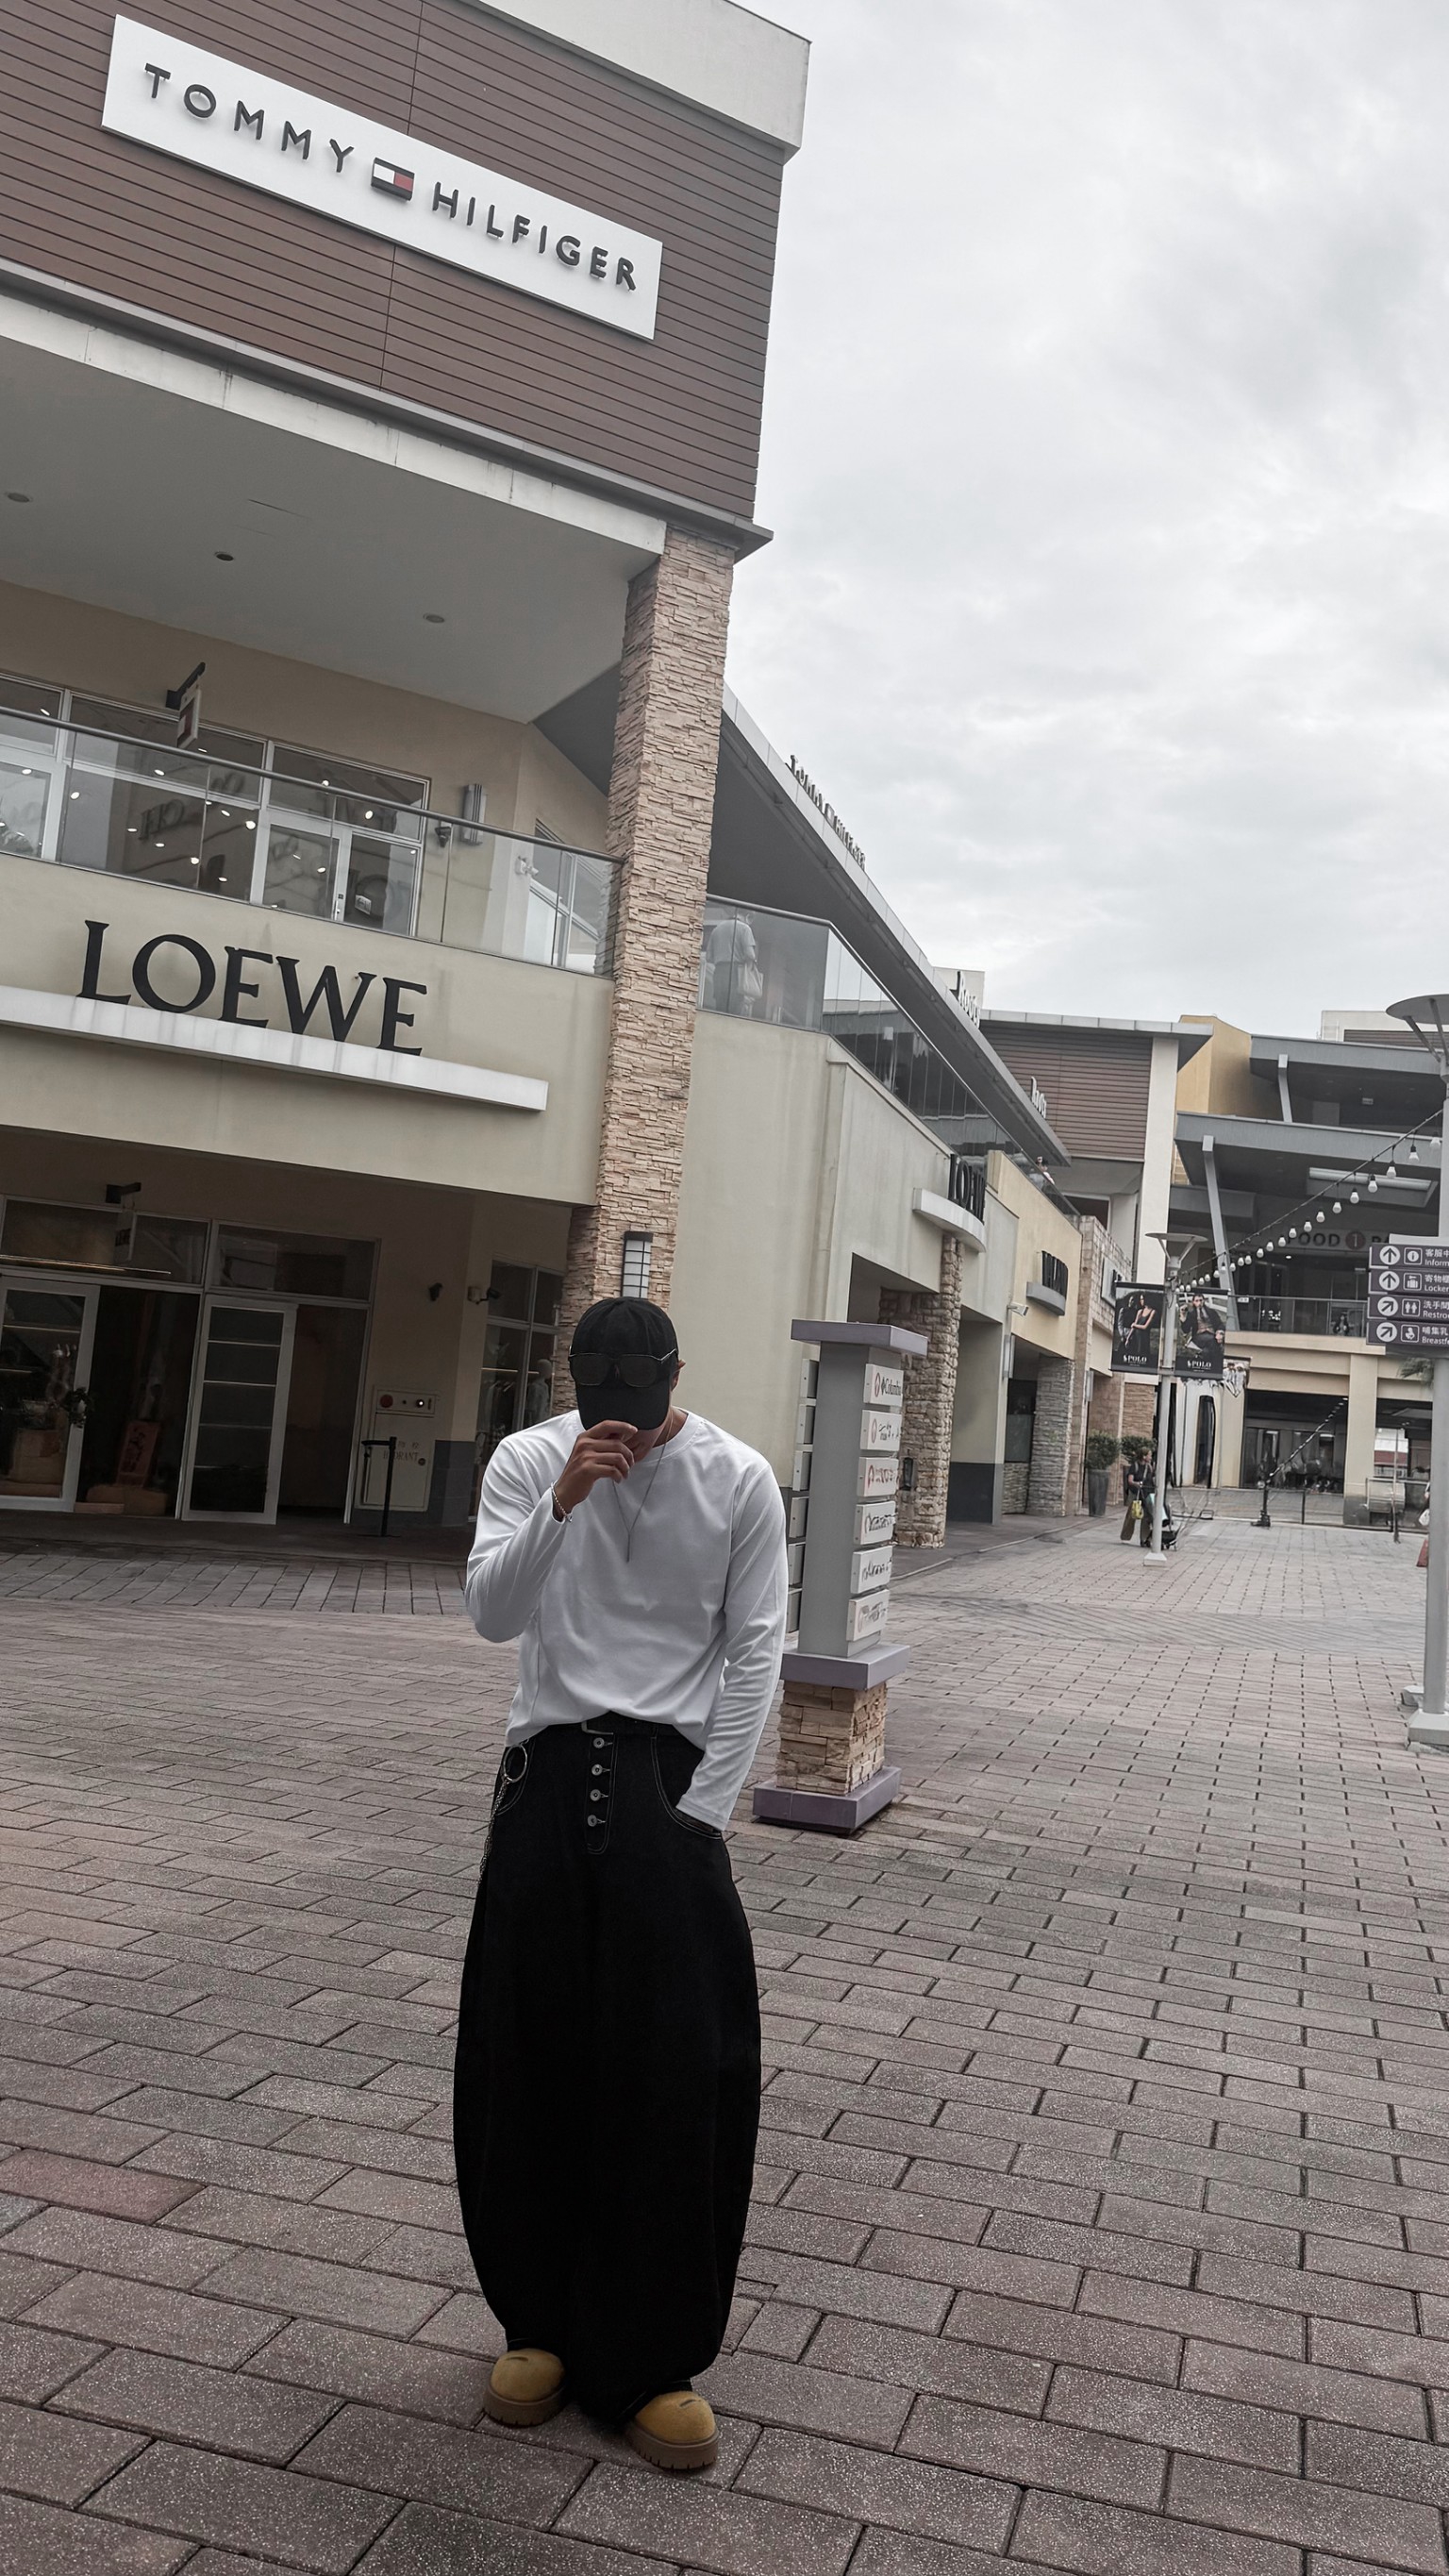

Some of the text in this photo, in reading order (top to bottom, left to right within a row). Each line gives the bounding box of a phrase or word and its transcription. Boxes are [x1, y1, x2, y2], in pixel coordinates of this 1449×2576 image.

[144, 62, 639, 293] TOMMY HILFIGER
[77, 919, 428, 1056] LOEWE
[1128, 1354, 1147, 1363] POLO
[1191, 1360, 1211, 1368] POLO
[383, 1449, 419, 1462] HDRANT
